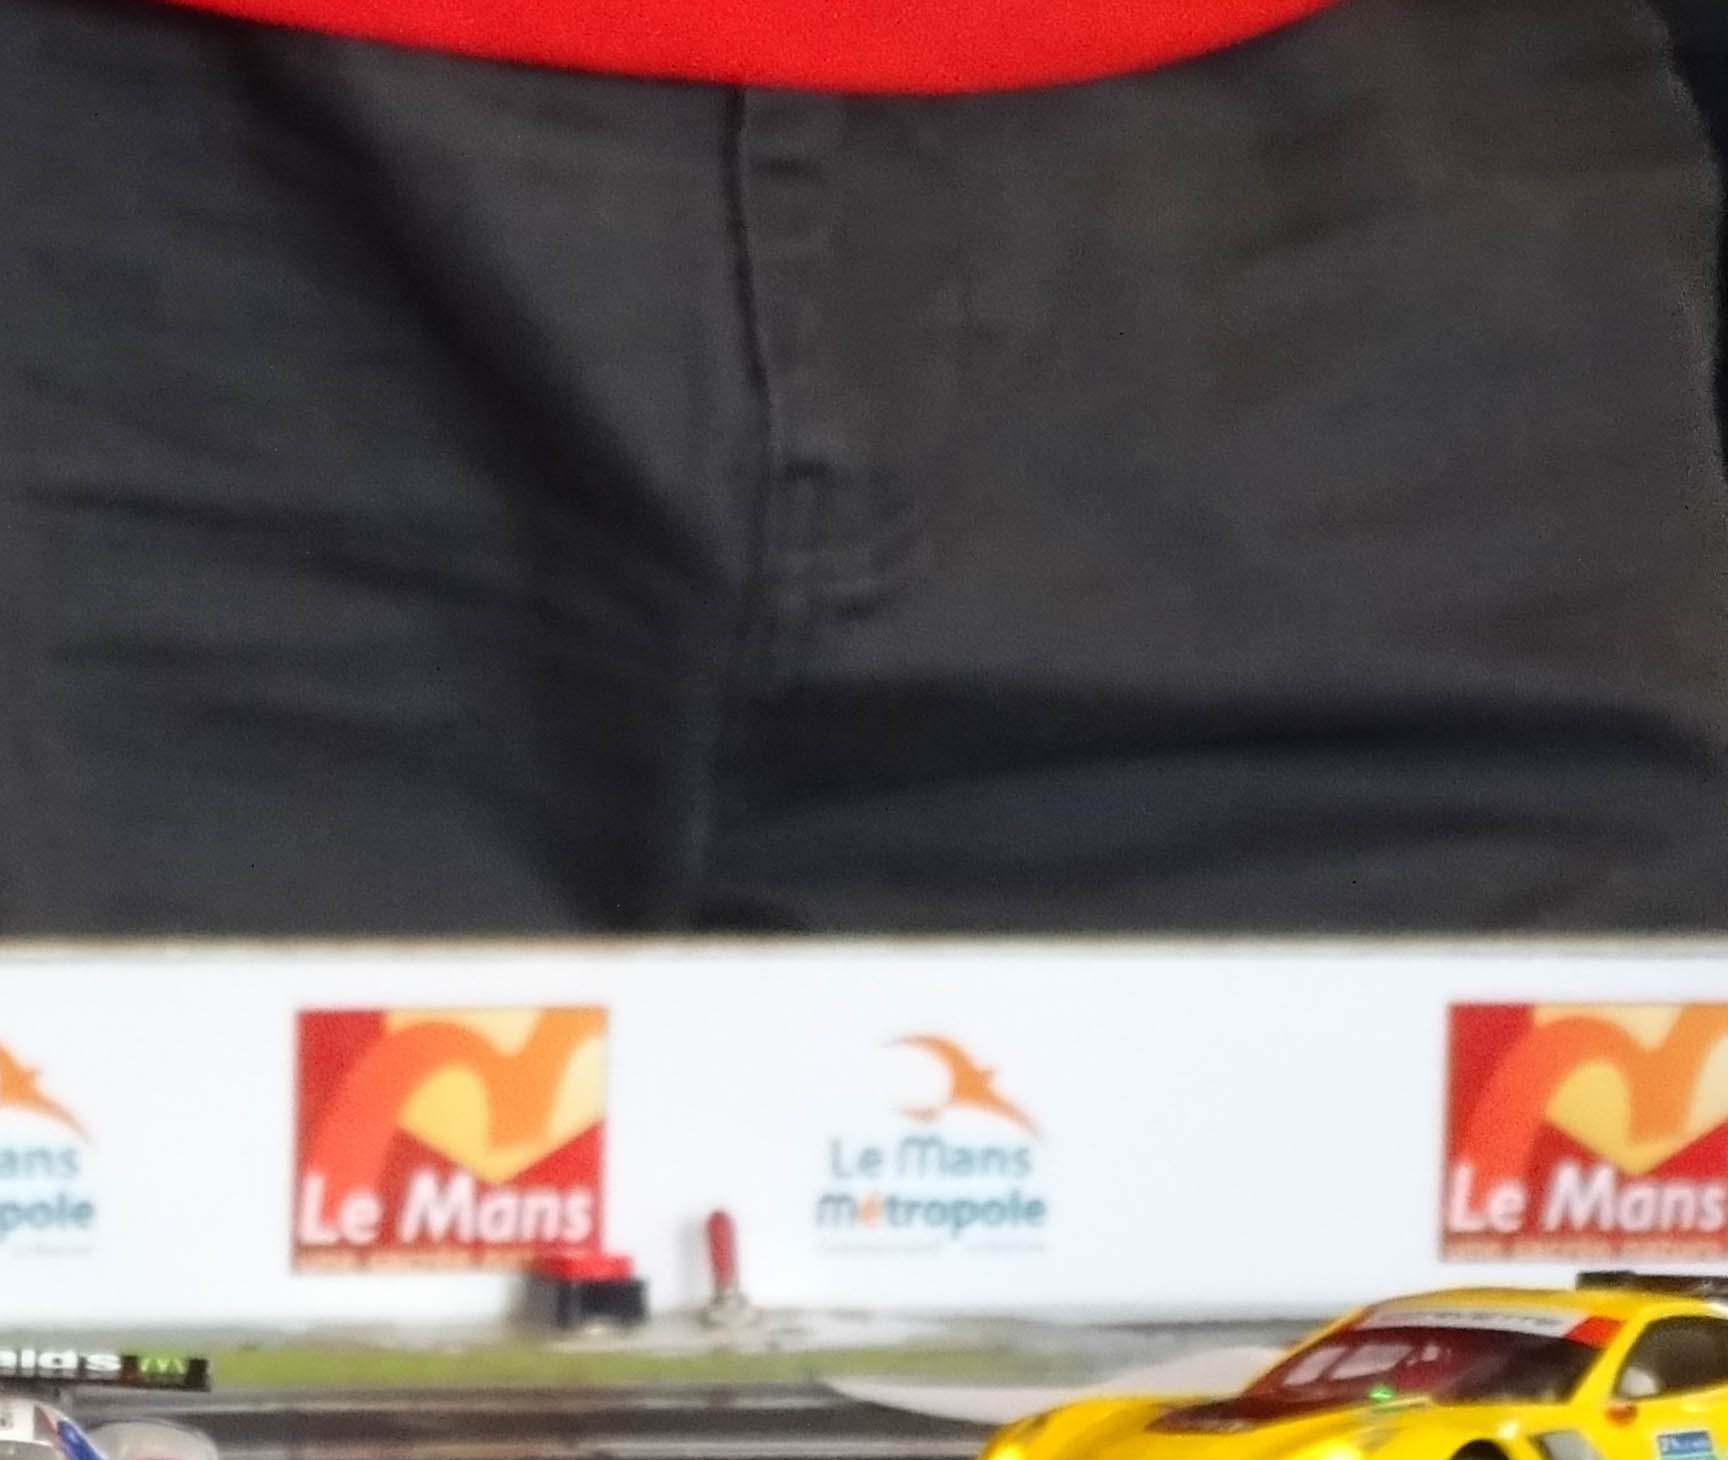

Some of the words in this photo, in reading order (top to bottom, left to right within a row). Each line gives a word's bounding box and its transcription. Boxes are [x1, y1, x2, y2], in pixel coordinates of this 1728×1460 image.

[830, 1137, 885, 1178] Le
[899, 1134, 1033, 1178] Mans
[300, 1173, 381, 1245] Le
[399, 1171, 592, 1244] Mans
[1448, 1166, 1527, 1233] Le
[1544, 1166, 1727, 1233] Mans
